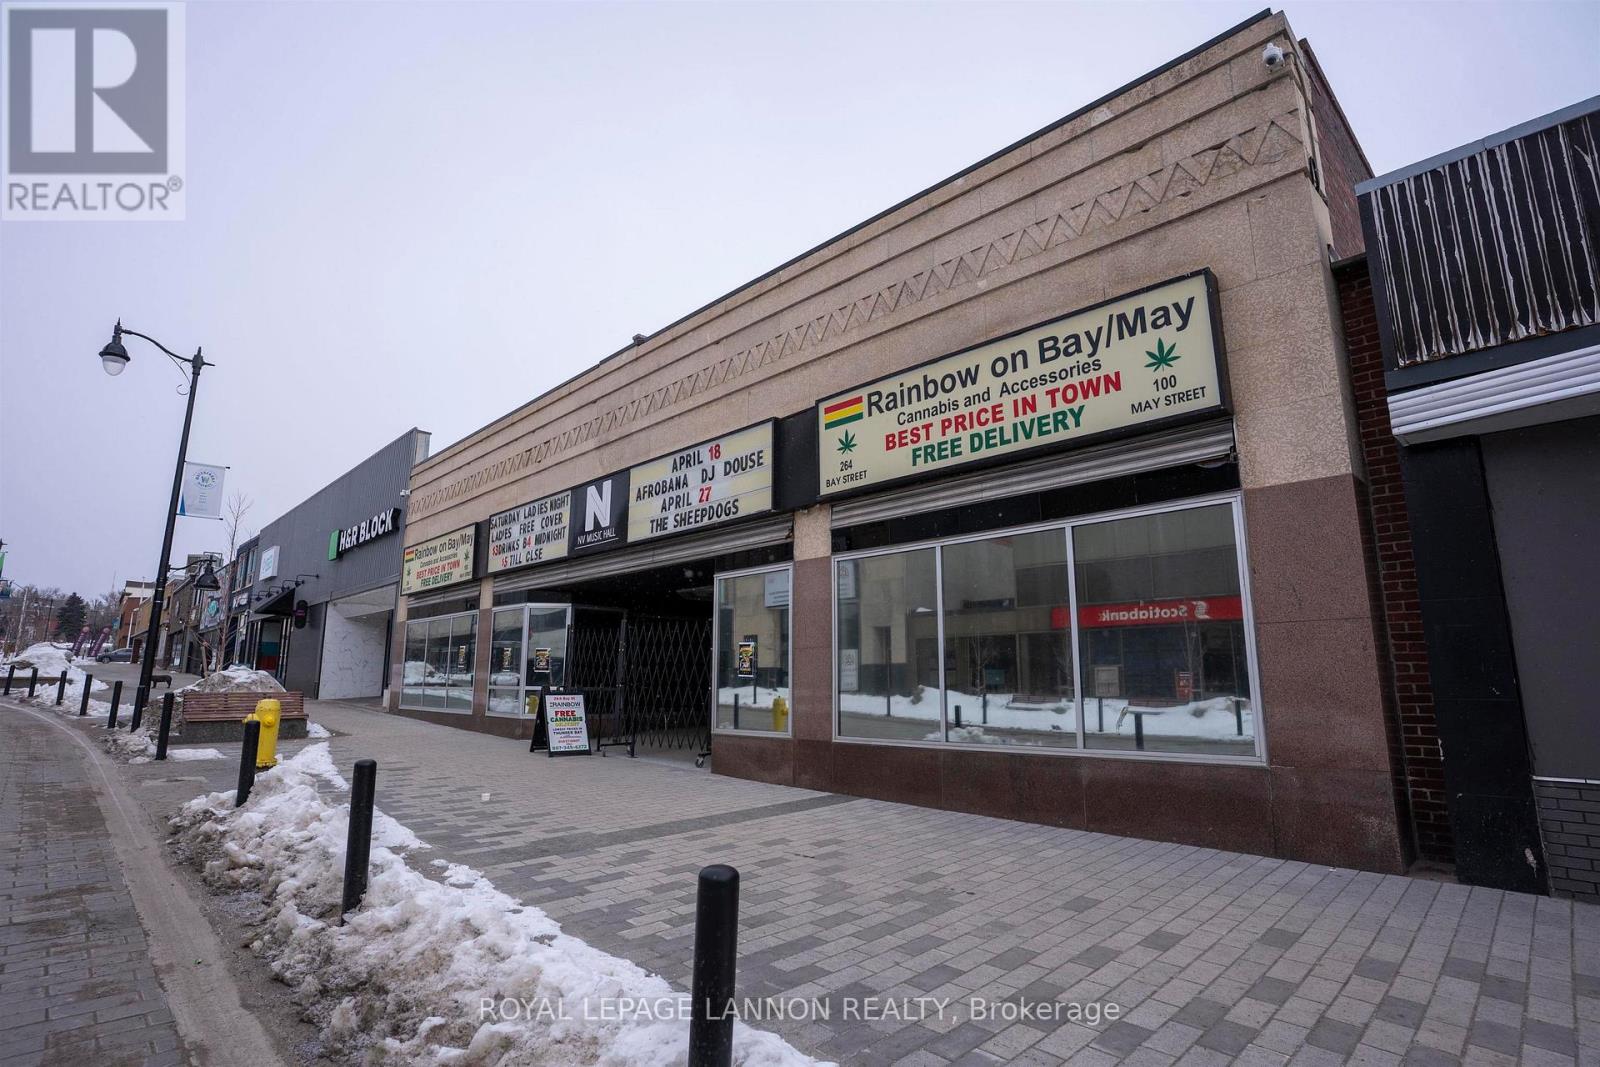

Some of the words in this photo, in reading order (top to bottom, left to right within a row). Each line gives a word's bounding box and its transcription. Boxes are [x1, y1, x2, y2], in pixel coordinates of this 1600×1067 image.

[867, 364, 980, 418] Rainbow
[991, 349, 1029, 378] on
[1038, 296, 1195, 364] Bay/May
[897, 399, 959, 426] Cannabis
[964, 387, 991, 408] and
[1000, 358, 1102, 398] Accessories
[1153, 375, 1177, 392] 100
[885, 422, 934, 451] BEST
[941, 403, 1005, 437] PRICE
[1013, 394, 1037, 418] IN
[1045, 371, 1122, 409] TOWN
[1131, 397, 1160, 415] MAY
[1164, 386, 1206, 407] STREET
[911, 437, 963, 467] FREE
[969, 405, 1085, 454] DELIVERY
[671, 450, 704, 473] APRIL
[708, 443, 721, 461] 18
[840, 459, 853, 472] 264
[636, 473, 689, 502] AFROBANA
[701, 465, 715, 484] DJ
[723, 450, 764, 477] DOUSE
[826, 476, 842, 488] BAY
[843, 470, 867, 484] STREET
[490, 511, 520, 530] SATURDAY
[523, 501, 548, 519] LADIES
[549, 494, 570, 511] NIGHT
[584, 479, 612, 532] N
[660, 492, 692, 514] APRIL
[698, 486, 712, 504] 27
[338, 525, 358, 552] H&R
[359, 507, 394, 543] BLOCK
[491, 527, 512, 542] LADIES
[519, 520, 534, 534] FREE
[540, 512, 563, 529] COVER
[650, 516, 668, 534] THE
[673, 498, 739, 529] SHEEPDOGS
[534, 526, 567, 546] MIDNIGHT
[586, 530, 603, 543] MUSIC
[603, 527, 616, 539] HALL
[414, 544, 438, 561] Rainbow
[438, 541, 446, 552] on
[525, 548, 542, 562] CLSE
[416, 569, 427, 580] BEST
[427, 565, 440, 577] PRICE
[441, 563, 446, 573] IN
[445, 559, 460, 571] TOWN
[420, 576, 431, 587] FREE
[431, 571, 453, 585] DELIVERY
